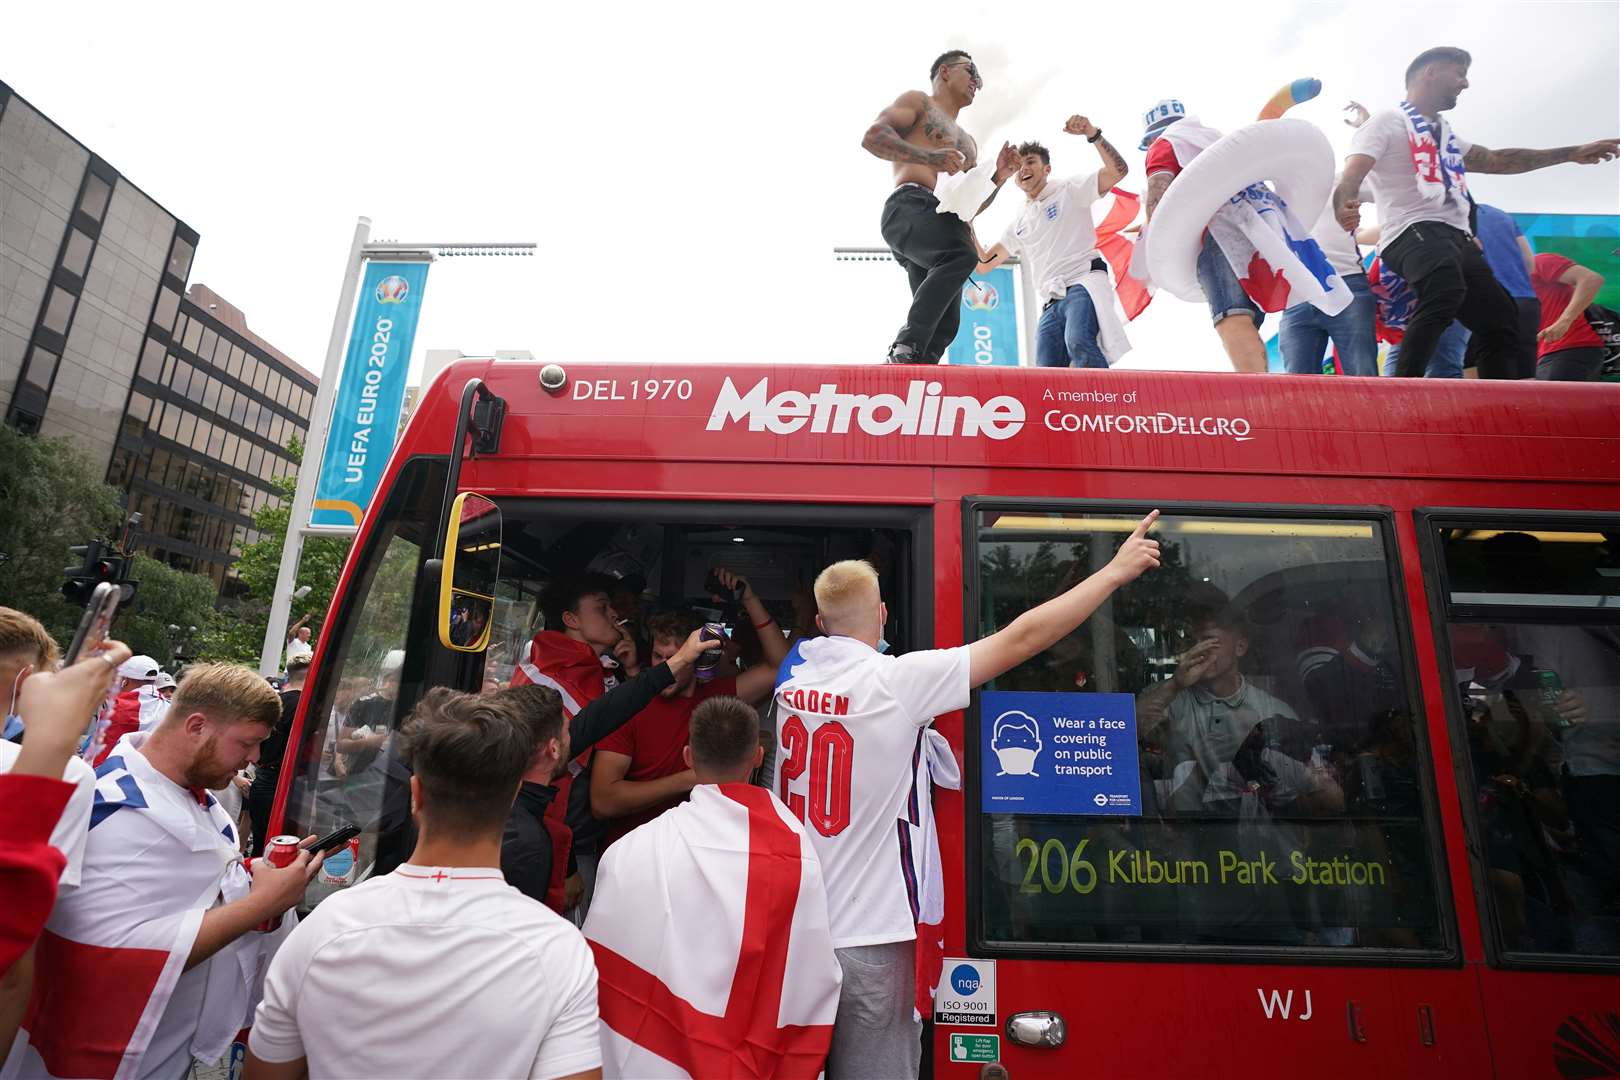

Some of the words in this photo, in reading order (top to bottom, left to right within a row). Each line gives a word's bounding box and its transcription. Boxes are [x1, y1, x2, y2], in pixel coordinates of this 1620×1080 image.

[369, 318, 393, 368] 2020
[356, 370, 382, 425] EURO
[1042, 389, 1055, 401] A
[1058, 390, 1118, 403] member
[1122, 391, 1137, 403] of
[705, 376, 1026, 440] Metroline
[345, 428, 372, 484] UEFA
[1053, 717, 1086, 729] Wear
[1088, 719, 1096, 729] a
[1099, 718, 1126, 729] face
[1053, 733, 1107, 747] covering
[1054, 750, 1071, 759] on
[1074, 748, 1112, 762] public
[781, 714, 854, 838] 20
[1054, 764, 1113, 777] transport
[1016, 838, 1097, 894] 206
[1108, 849, 1209, 885] Kilburn
[1218, 850, 1279, 885] Park
[1288, 850, 1385, 885] Station
[943, 1001, 960, 1010] ISO
[963, 1002, 987, 1011] 9001
[942, 1013, 990, 1024] Registered
